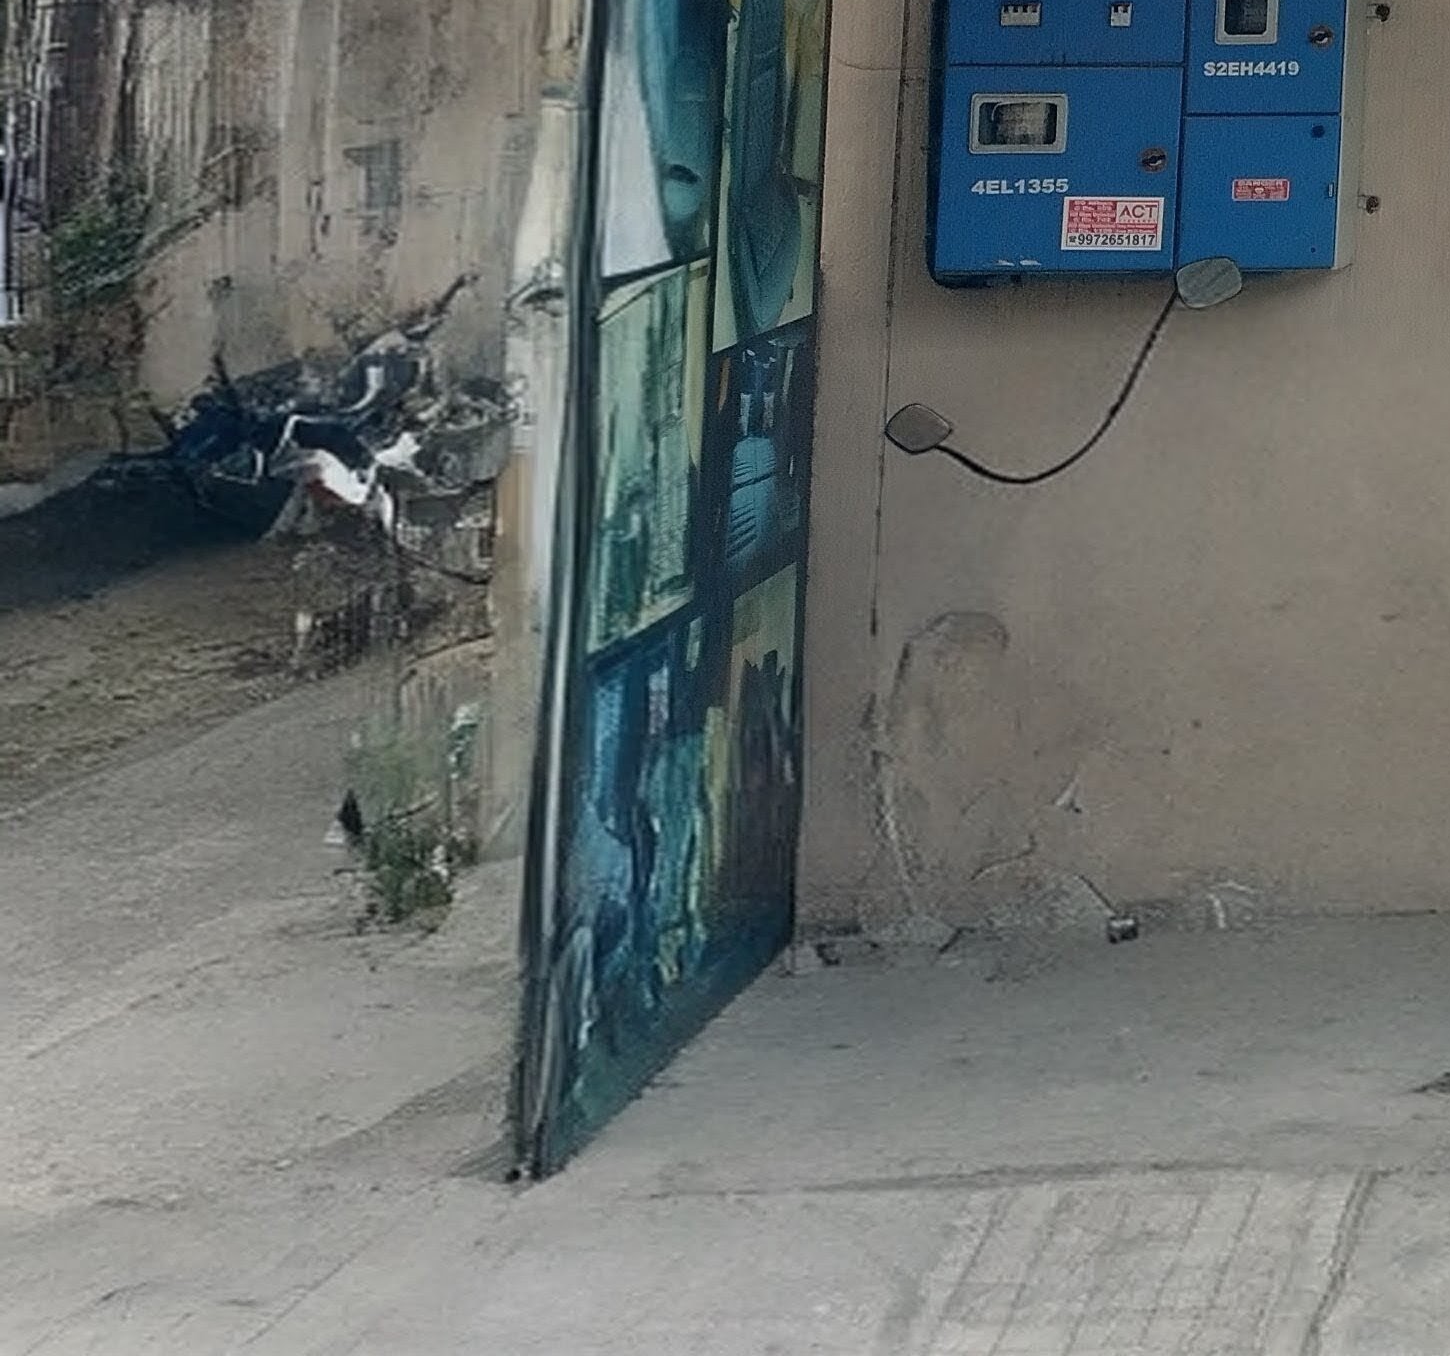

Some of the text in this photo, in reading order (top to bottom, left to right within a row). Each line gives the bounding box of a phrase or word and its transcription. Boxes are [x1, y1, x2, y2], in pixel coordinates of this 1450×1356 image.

[1203, 61, 1300, 77] S2EH4419
[970, 179, 1069, 195] 4EL1355
[1119, 205, 1157, 219] ACT
[1077, 233, 1156, 246] 9972651817
